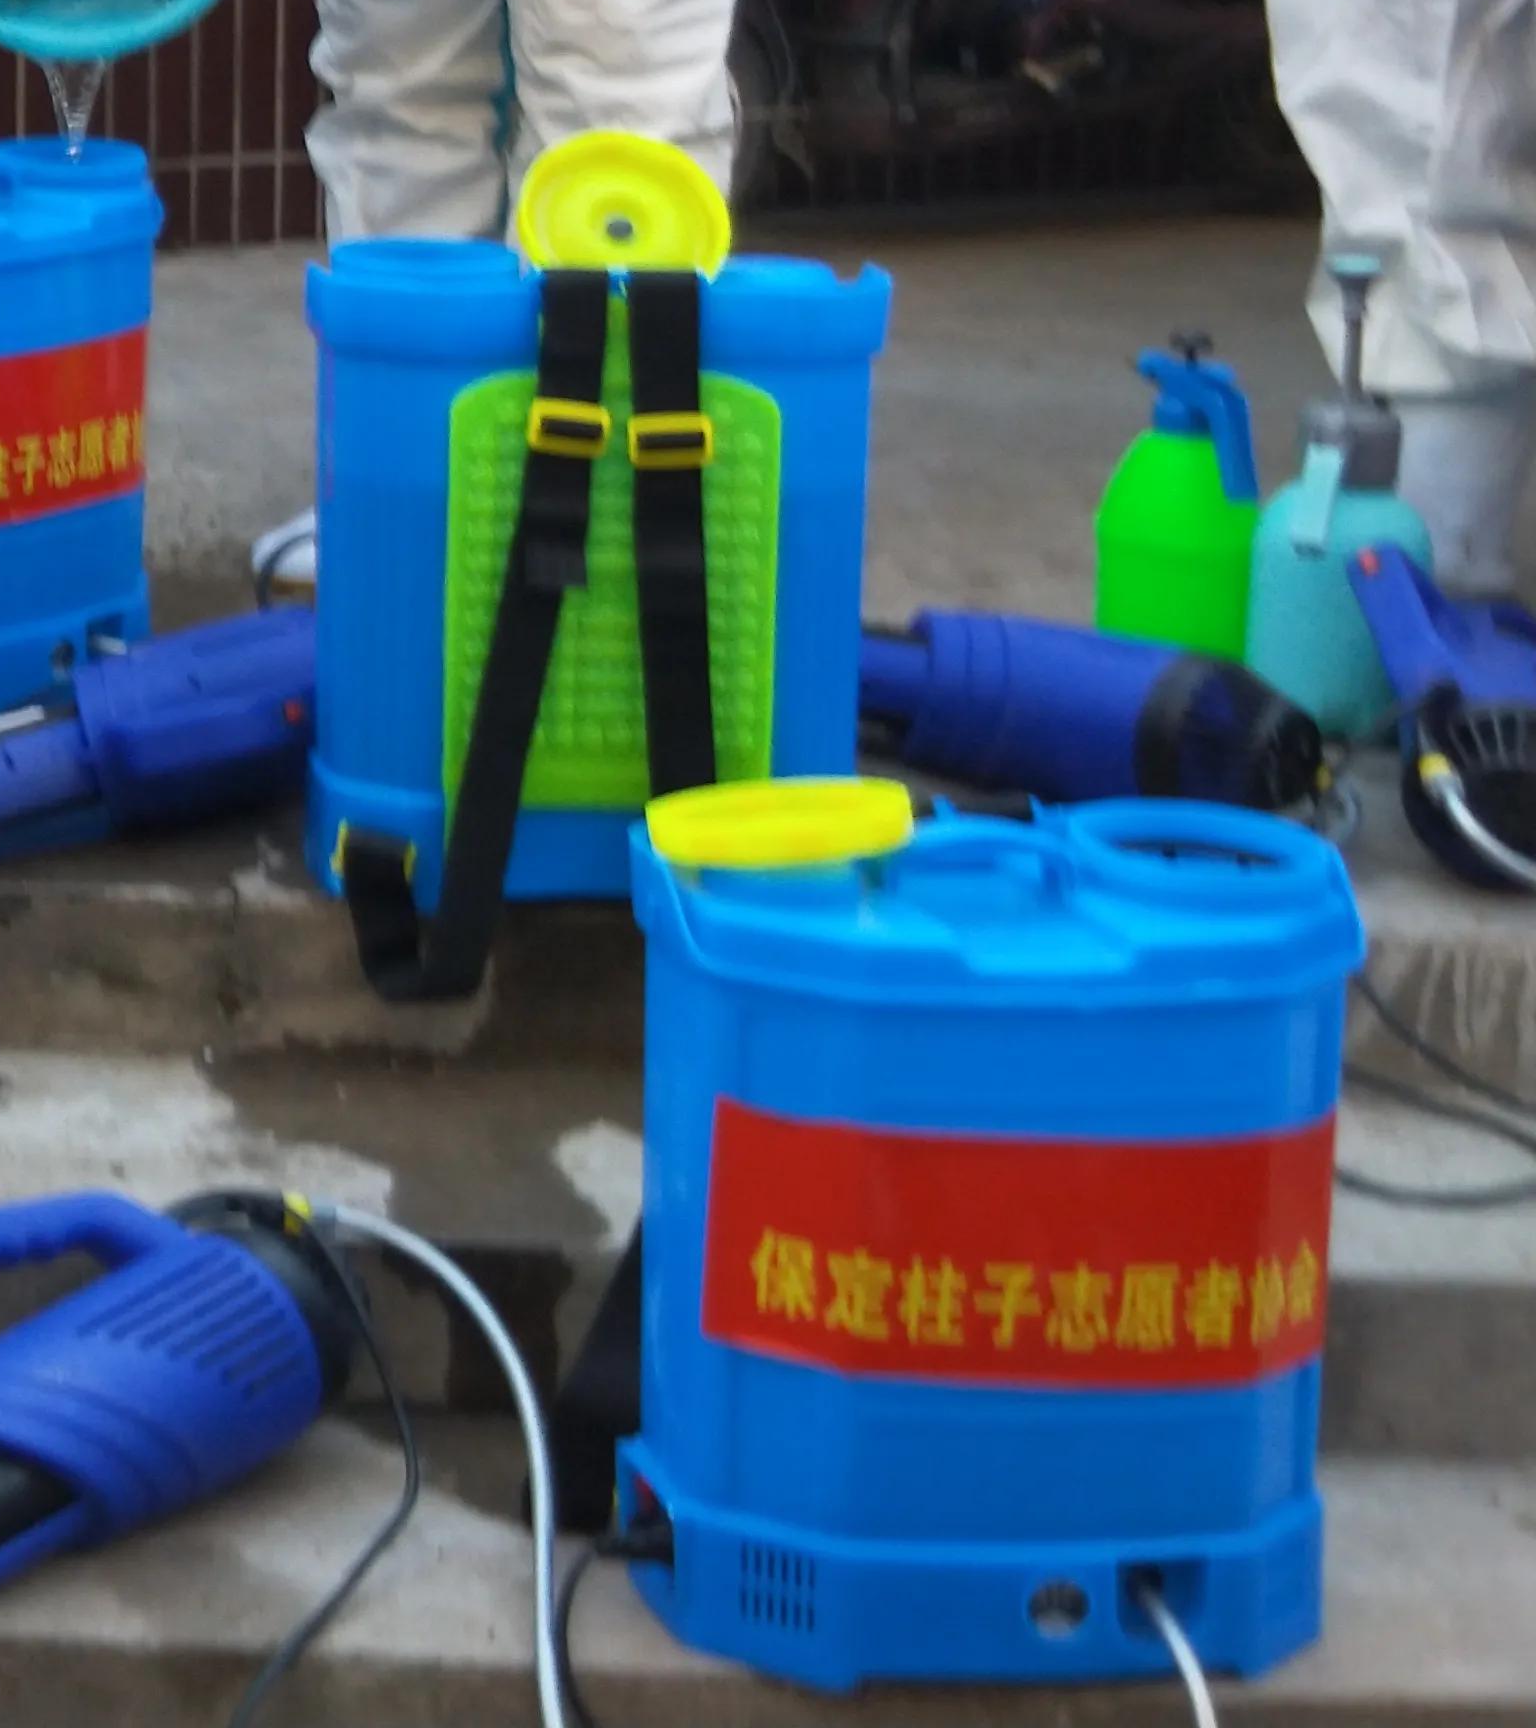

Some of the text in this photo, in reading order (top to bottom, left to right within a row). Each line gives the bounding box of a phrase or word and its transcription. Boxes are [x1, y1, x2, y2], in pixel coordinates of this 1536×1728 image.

[750, 1227, 1319, 1352] 保定柱子志愿者协会
